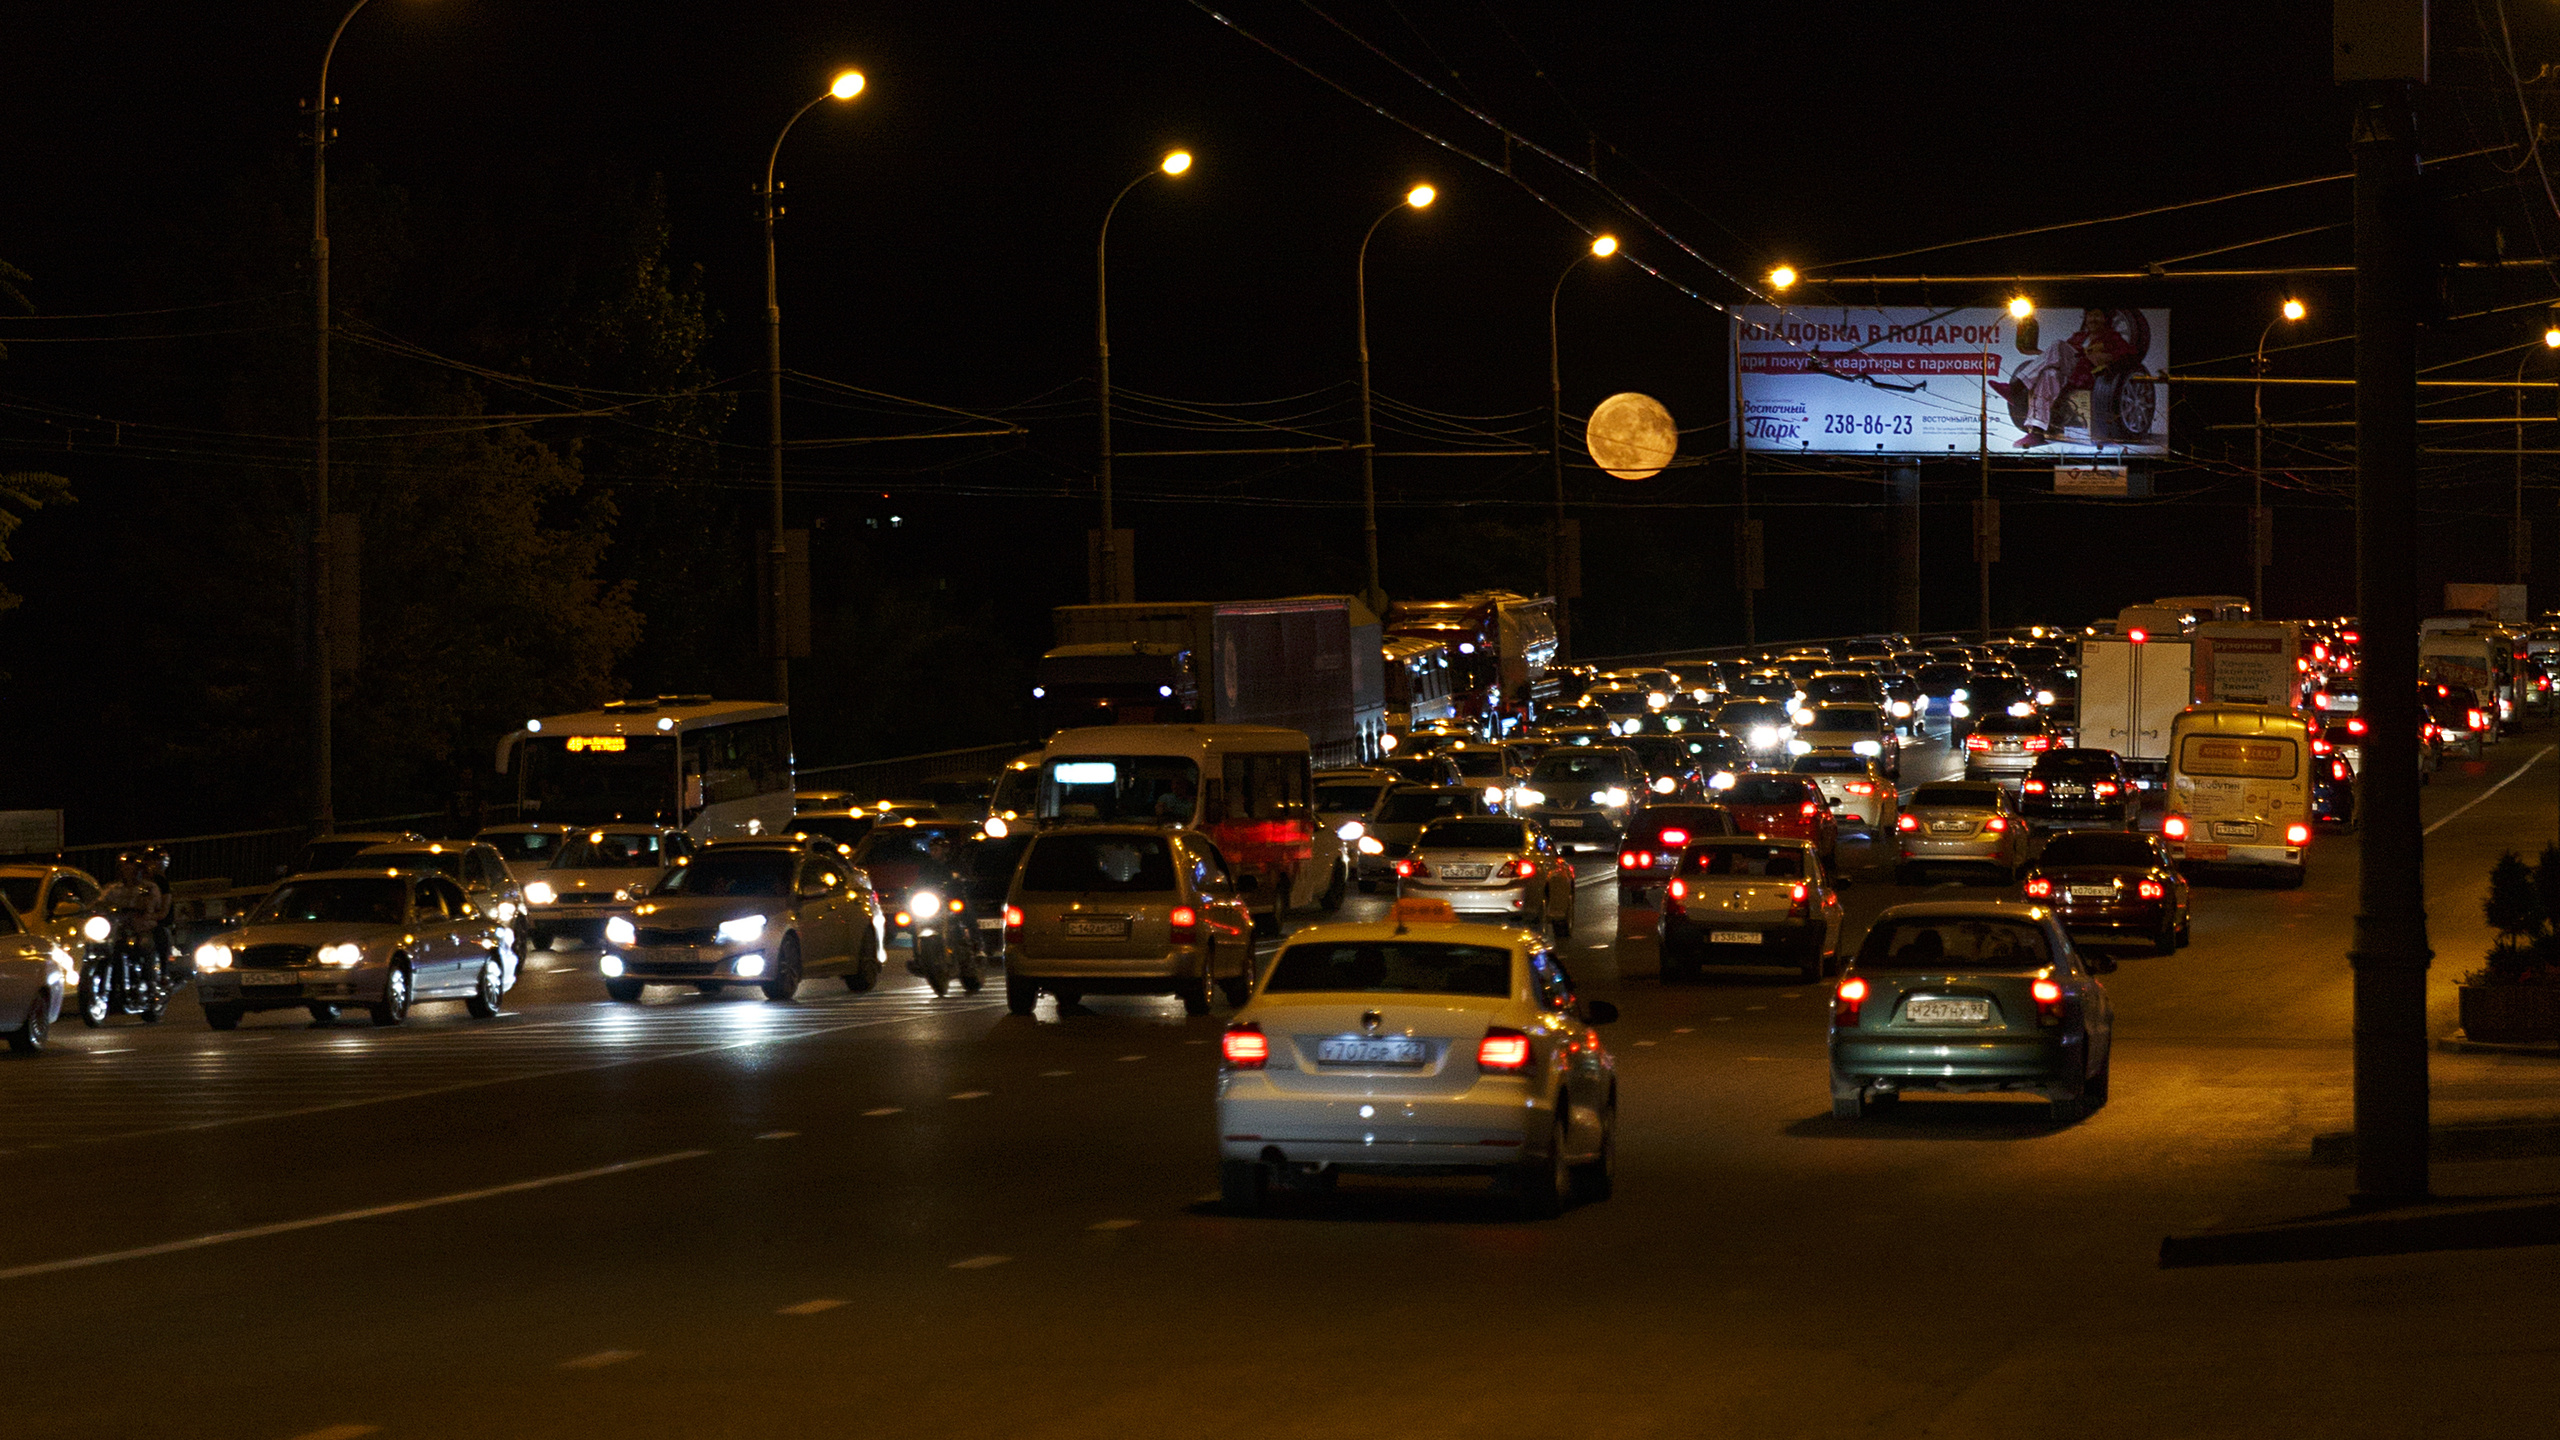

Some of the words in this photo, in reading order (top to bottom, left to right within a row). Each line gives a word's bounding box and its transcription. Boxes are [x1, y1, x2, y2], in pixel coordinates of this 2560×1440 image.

[1740, 323, 1861, 344] КЛАДОВКА
[1868, 324, 1880, 343] В
[1888, 324, 2000, 346] ПОДАРОК!
[1741, 356, 1766, 369] при
[1834, 357, 1903, 372] квартиры
[1907, 359, 1915, 369] с
[1744, 400, 1806, 413] Восточный
[1745, 416, 1801, 443] Парк
[1824, 414, 1913, 435] 238-86-23
